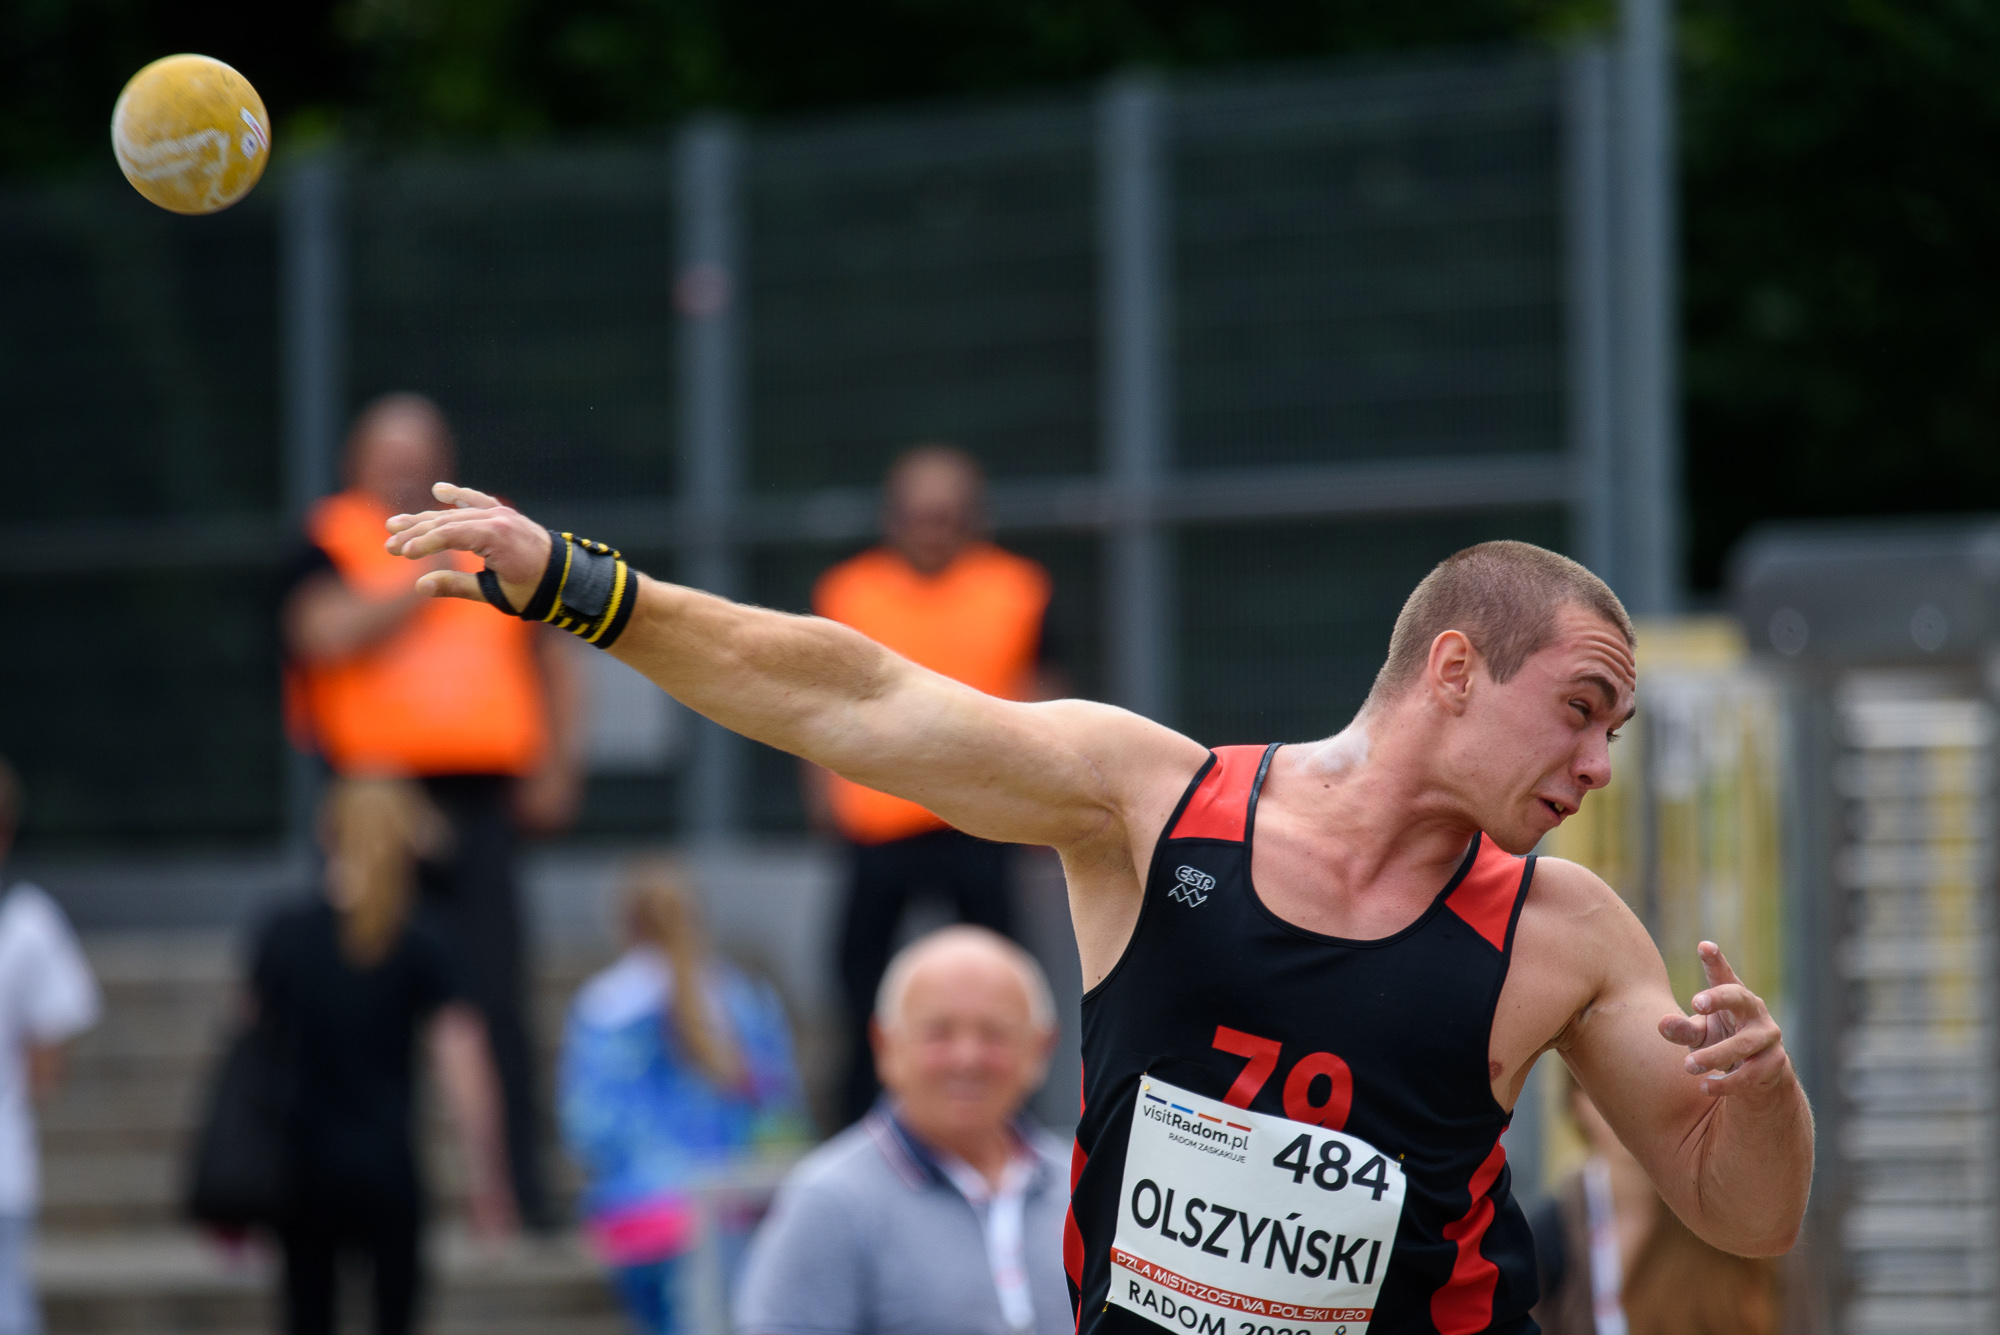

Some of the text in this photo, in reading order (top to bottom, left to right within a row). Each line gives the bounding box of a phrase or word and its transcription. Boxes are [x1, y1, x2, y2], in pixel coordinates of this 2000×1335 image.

[1212, 1025, 1353, 1132] 79
[1143, 1104, 1249, 1151] visitRadom.pl
[1168, 1132, 1247, 1164] RADOM ZASKAKUJE
[1272, 1133, 1390, 1202] 484
[1131, 1178, 1383, 1286] OLSZYŃSKI
[1116, 1252, 1367, 1321] PZLA MISTRZOSTWA POLSKI U20
[1128, 1279, 1227, 1335] RADOM
